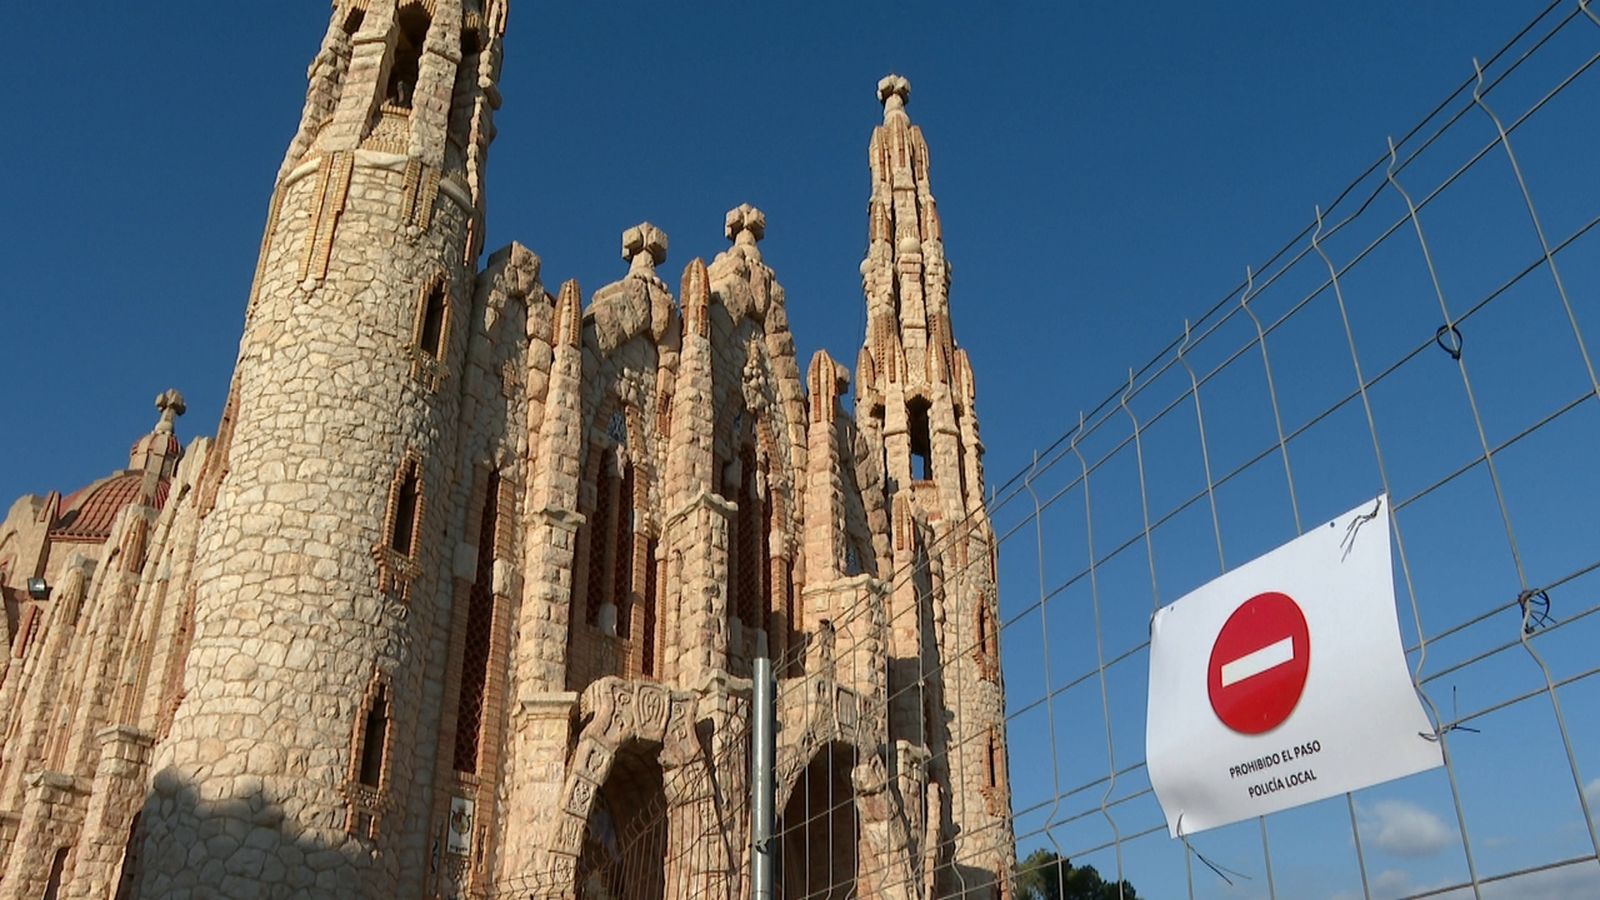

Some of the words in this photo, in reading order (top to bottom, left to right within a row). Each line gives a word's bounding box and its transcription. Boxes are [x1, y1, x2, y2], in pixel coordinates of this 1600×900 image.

[1229, 753, 1281, 778] PROHIBIDO
[1281, 749, 1293, 762] EL
[1294, 740, 1321, 758] PASO
[1248, 777, 1285, 798] POLICÍA
[1286, 769, 1317, 788] LOCAL
